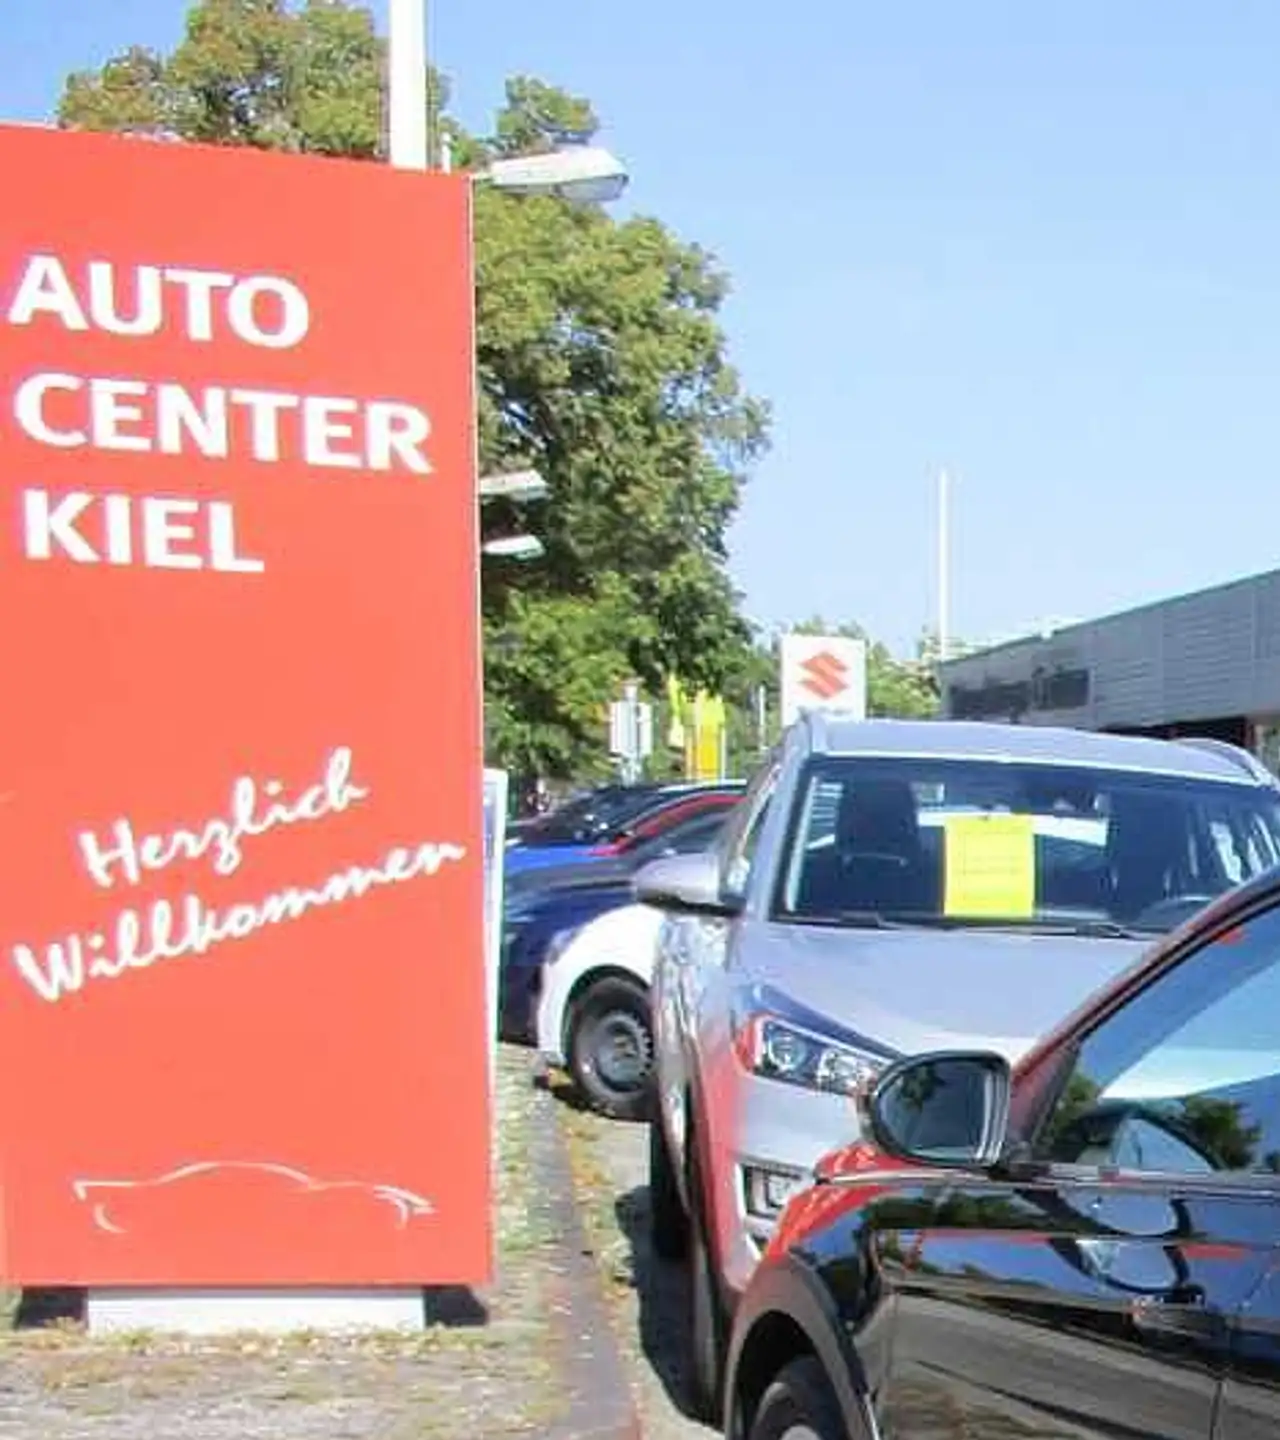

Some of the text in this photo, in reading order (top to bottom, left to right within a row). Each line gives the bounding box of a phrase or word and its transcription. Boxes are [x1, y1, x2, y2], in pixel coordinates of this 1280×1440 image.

[8, 255, 310, 348] AUTO
[12, 372, 434, 475] CENTER
[22, 488, 266, 572] KIEL
[77, 745, 371, 887] Herzlich
[12, 838, 467, 1003] Willkommen
